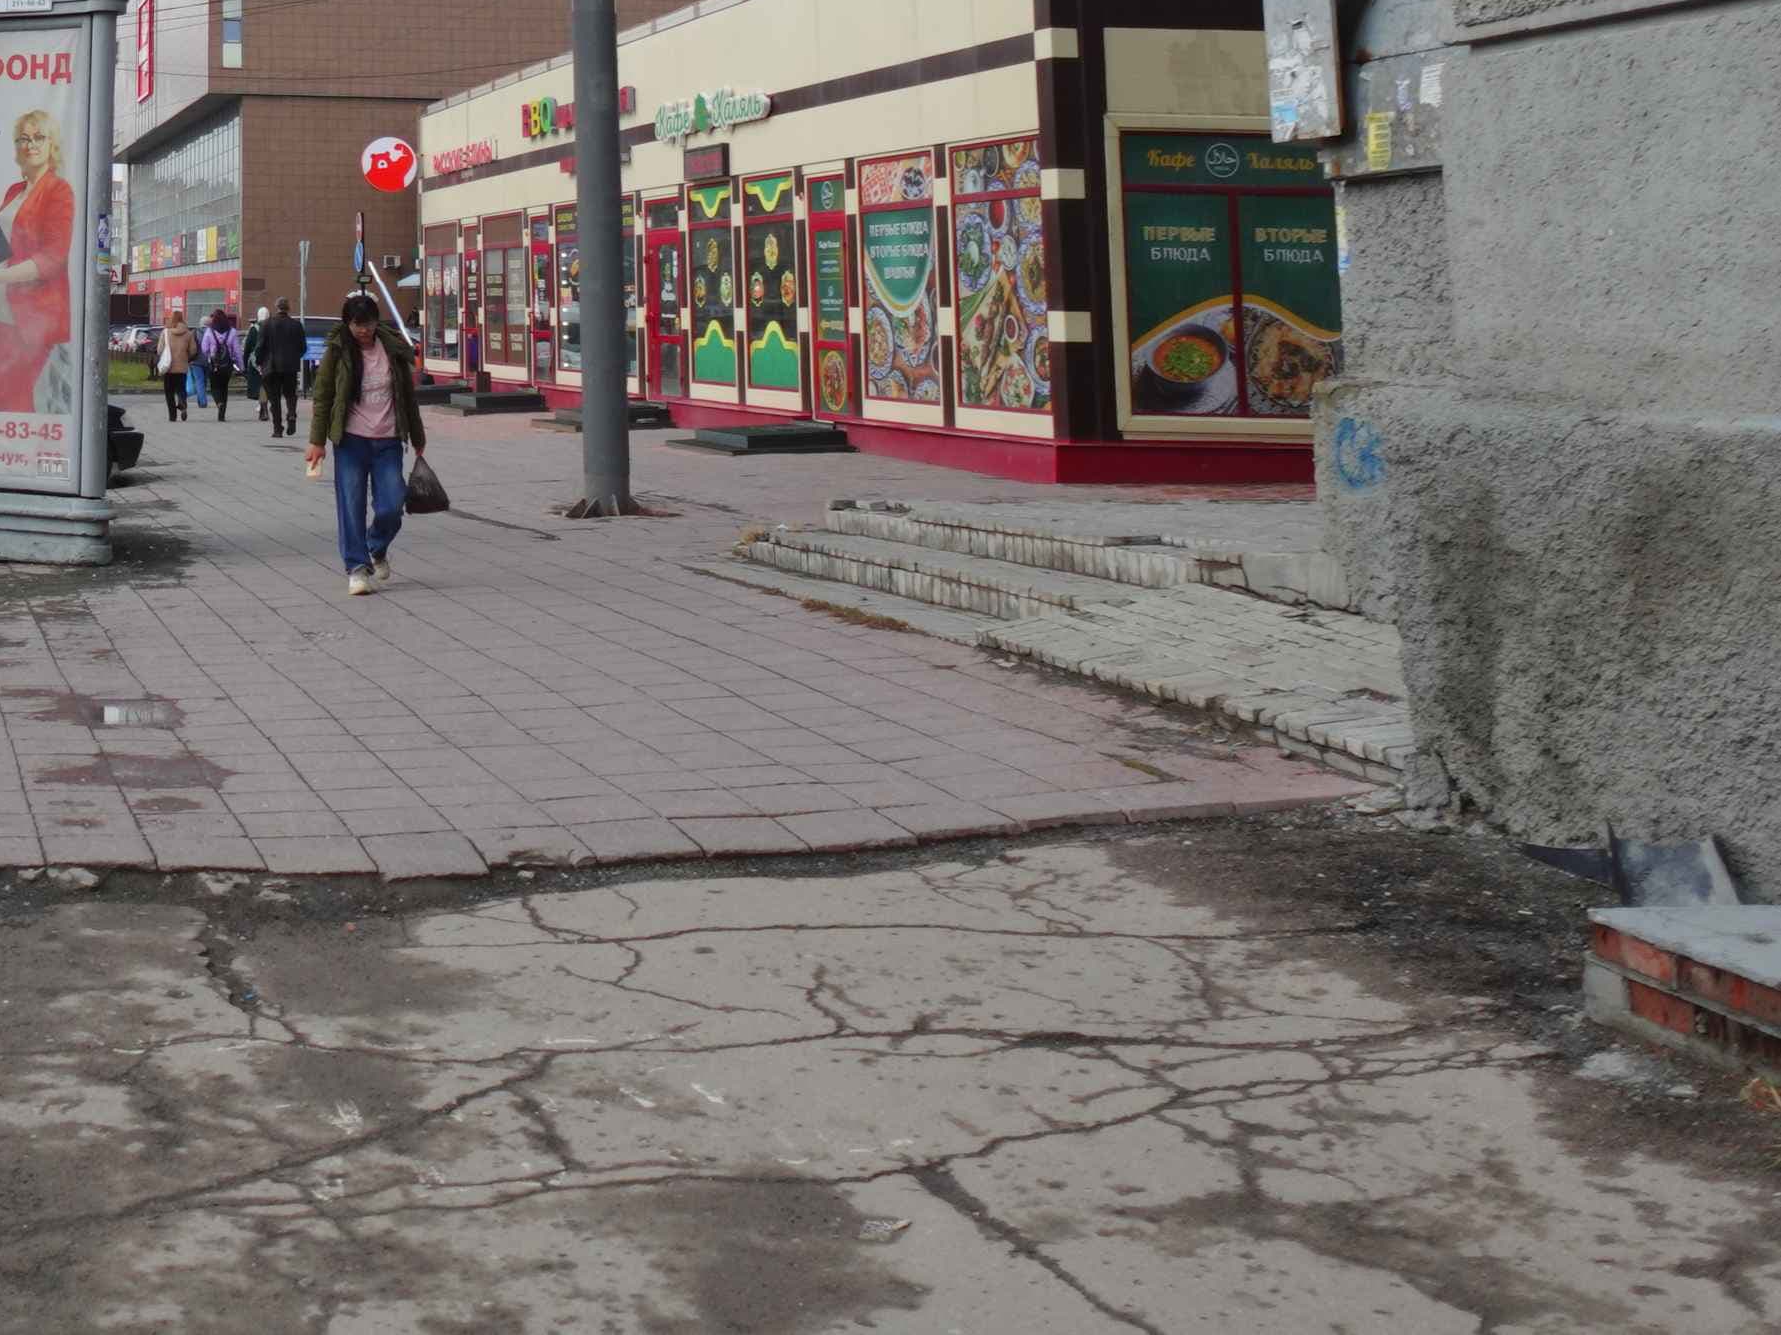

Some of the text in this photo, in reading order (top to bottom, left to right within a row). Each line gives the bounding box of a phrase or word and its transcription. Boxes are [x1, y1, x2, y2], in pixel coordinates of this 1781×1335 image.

[1147, 149, 1197, 172] Кафе
[1143, 226, 1217, 242] ПЕРВЫЕ
[1254, 227, 1328, 244] ВТОРЫЕ
[1150, 247, 1212, 263] БЛЮДА
[1263, 248, 1324, 264] БЛЮДА
